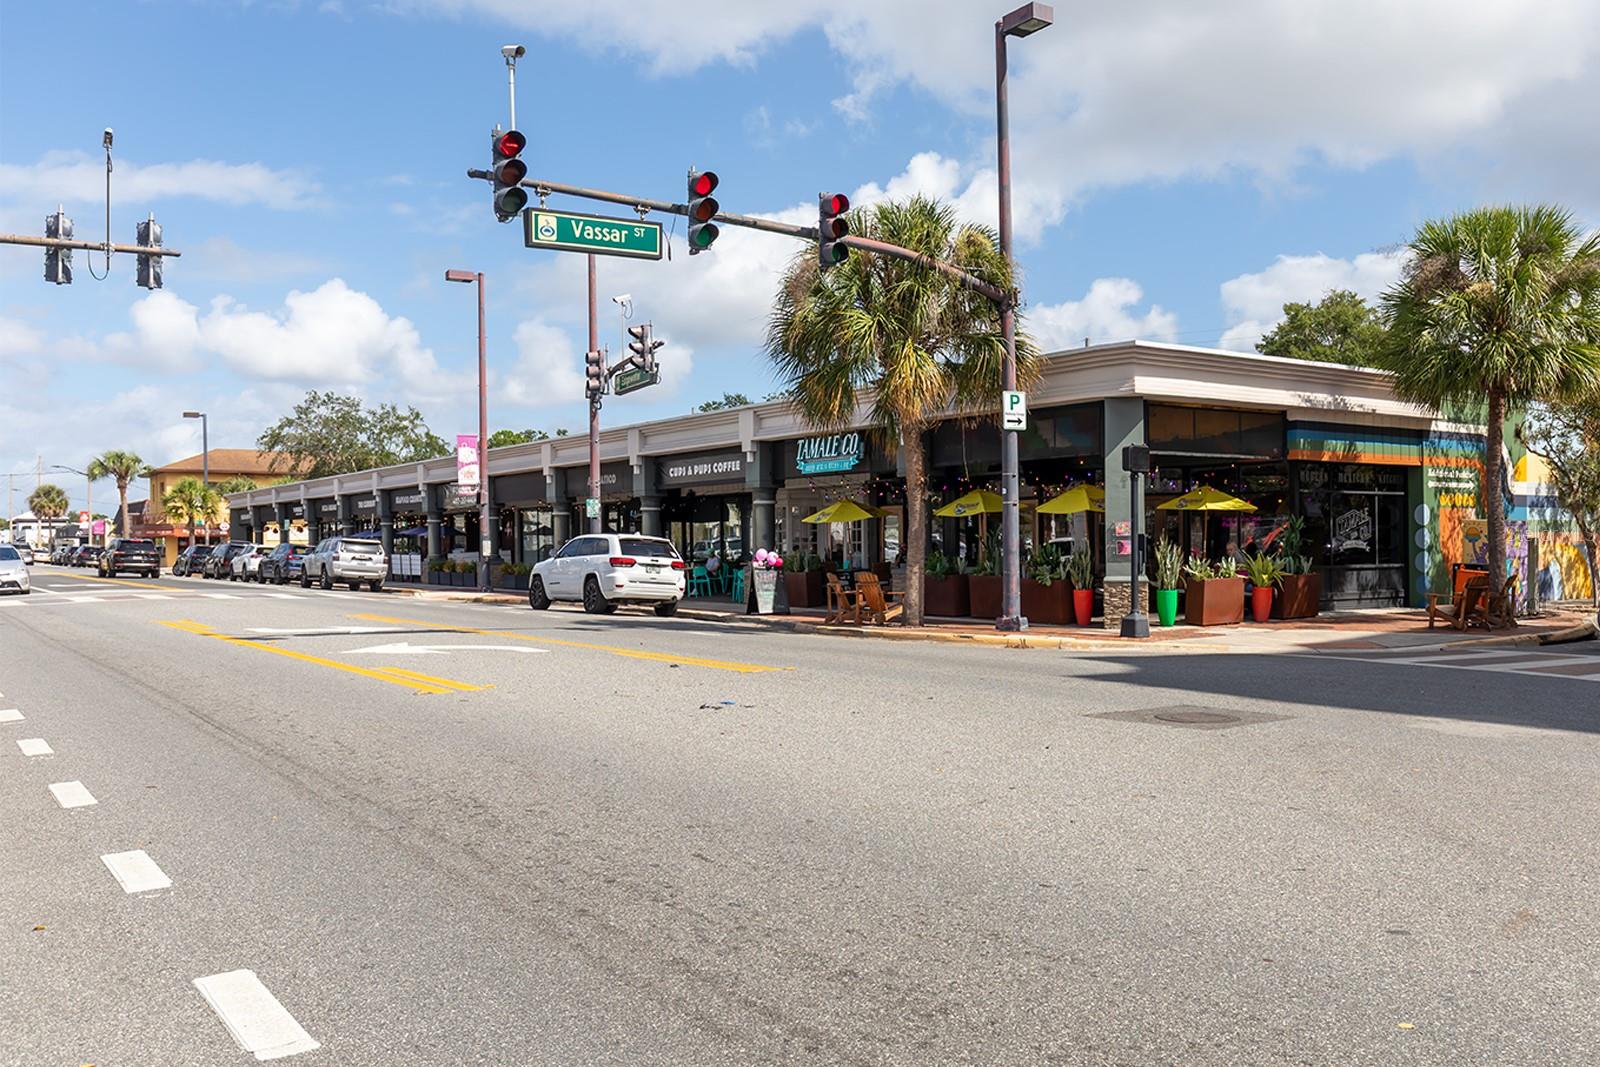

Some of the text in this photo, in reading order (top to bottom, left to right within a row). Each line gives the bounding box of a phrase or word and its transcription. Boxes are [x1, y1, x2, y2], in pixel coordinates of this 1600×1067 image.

[571, 220, 645, 243] Vassar ST
[1010, 394, 1020, 411] P
[796, 432, 859, 460] TAMALE CO.
[669, 466, 686, 478] CUPS
[693, 463, 711, 475] PUPS
[712, 460, 740, 473] COFFEE
